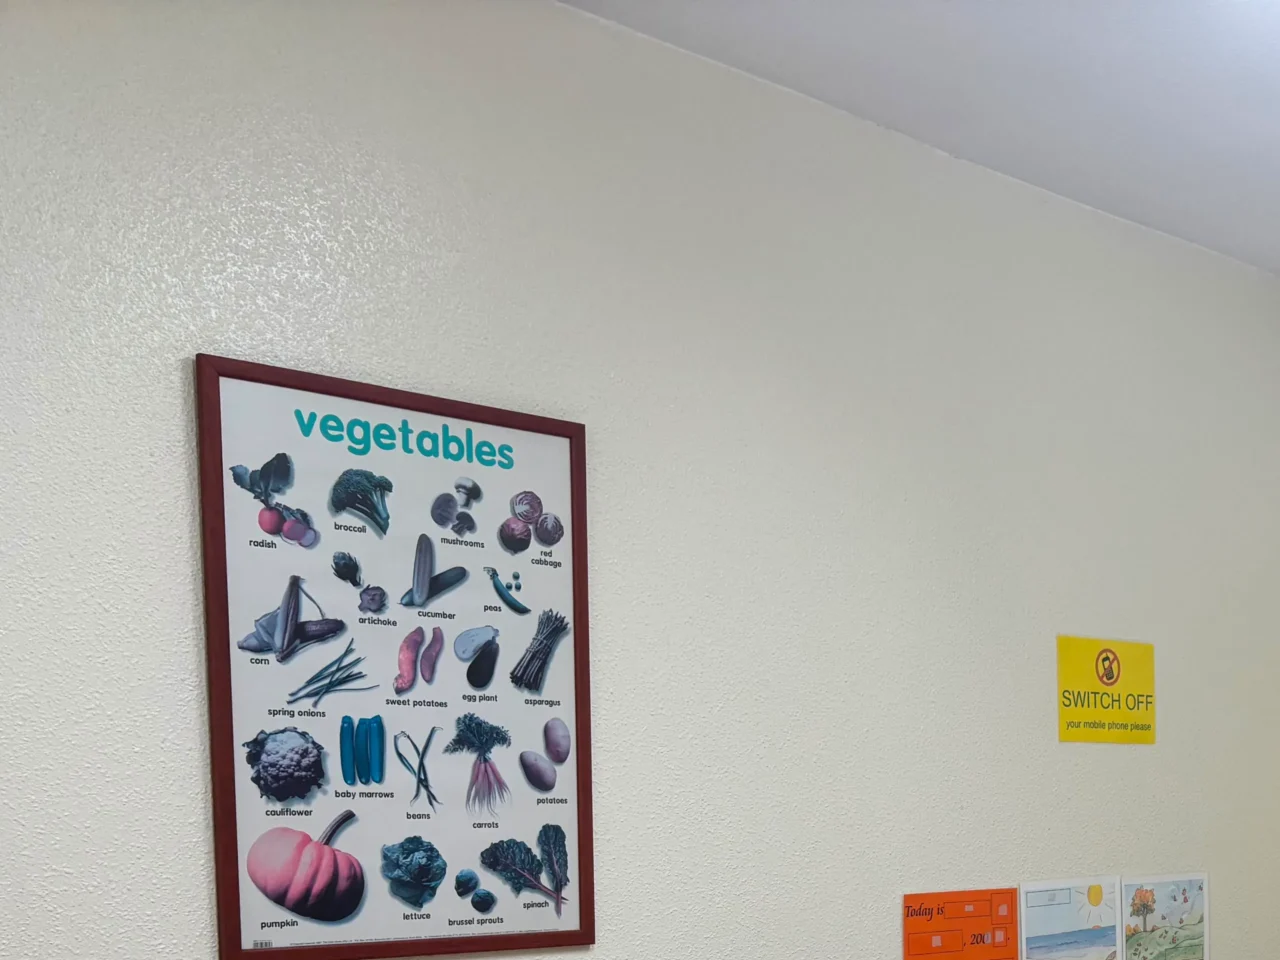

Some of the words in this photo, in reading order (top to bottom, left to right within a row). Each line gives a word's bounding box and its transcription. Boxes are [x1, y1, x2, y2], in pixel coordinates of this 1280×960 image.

[293, 408, 515, 470] vegetables
[333, 521, 367, 534] broccoli
[248, 539, 277, 549] radish
[440, 536, 485, 549] mushrooms
[540, 550, 553, 558] red
[530, 557, 562, 569] cabbage
[483, 604, 502, 613] peas
[417, 610, 456, 620] cucumber
[358, 616, 397, 627] artichoke
[249, 656, 270, 665] corn
[385, 697, 411, 706] sweet
[412, 698, 448, 709] potatoes
[462, 693, 477, 702] egg
[478, 693, 498, 703] plant
[524, 698, 561, 708] asparagus
[1061, 689, 1122, 710] SWITCH
[1125, 693, 1154, 712] OFF
[267, 707, 295, 718] spring
[297, 708, 326, 718] onions
[1065, 720, 1082, 731] your
[1083, 720, 1106, 730] mobile
[1107, 720, 1129, 732] phone
[1130, 721, 1152, 733] please
[334, 789, 357, 800] baby
[358, 790, 395, 799] marrows
[536, 796, 568, 806] potatoes
[265, 807, 313, 817] cauliflower
[406, 811, 431, 820] beans
[472, 820, 499, 829] carrots
[522, 899, 550, 910] spinach
[402, 911, 431, 921] lettuce
[904, 902, 934, 922] Today
[936, 903, 945, 916] is
[260, 918, 299, 930] pumpkin
[447, 917, 475, 926] brussel
[476, 915, 504, 926] sprouts
